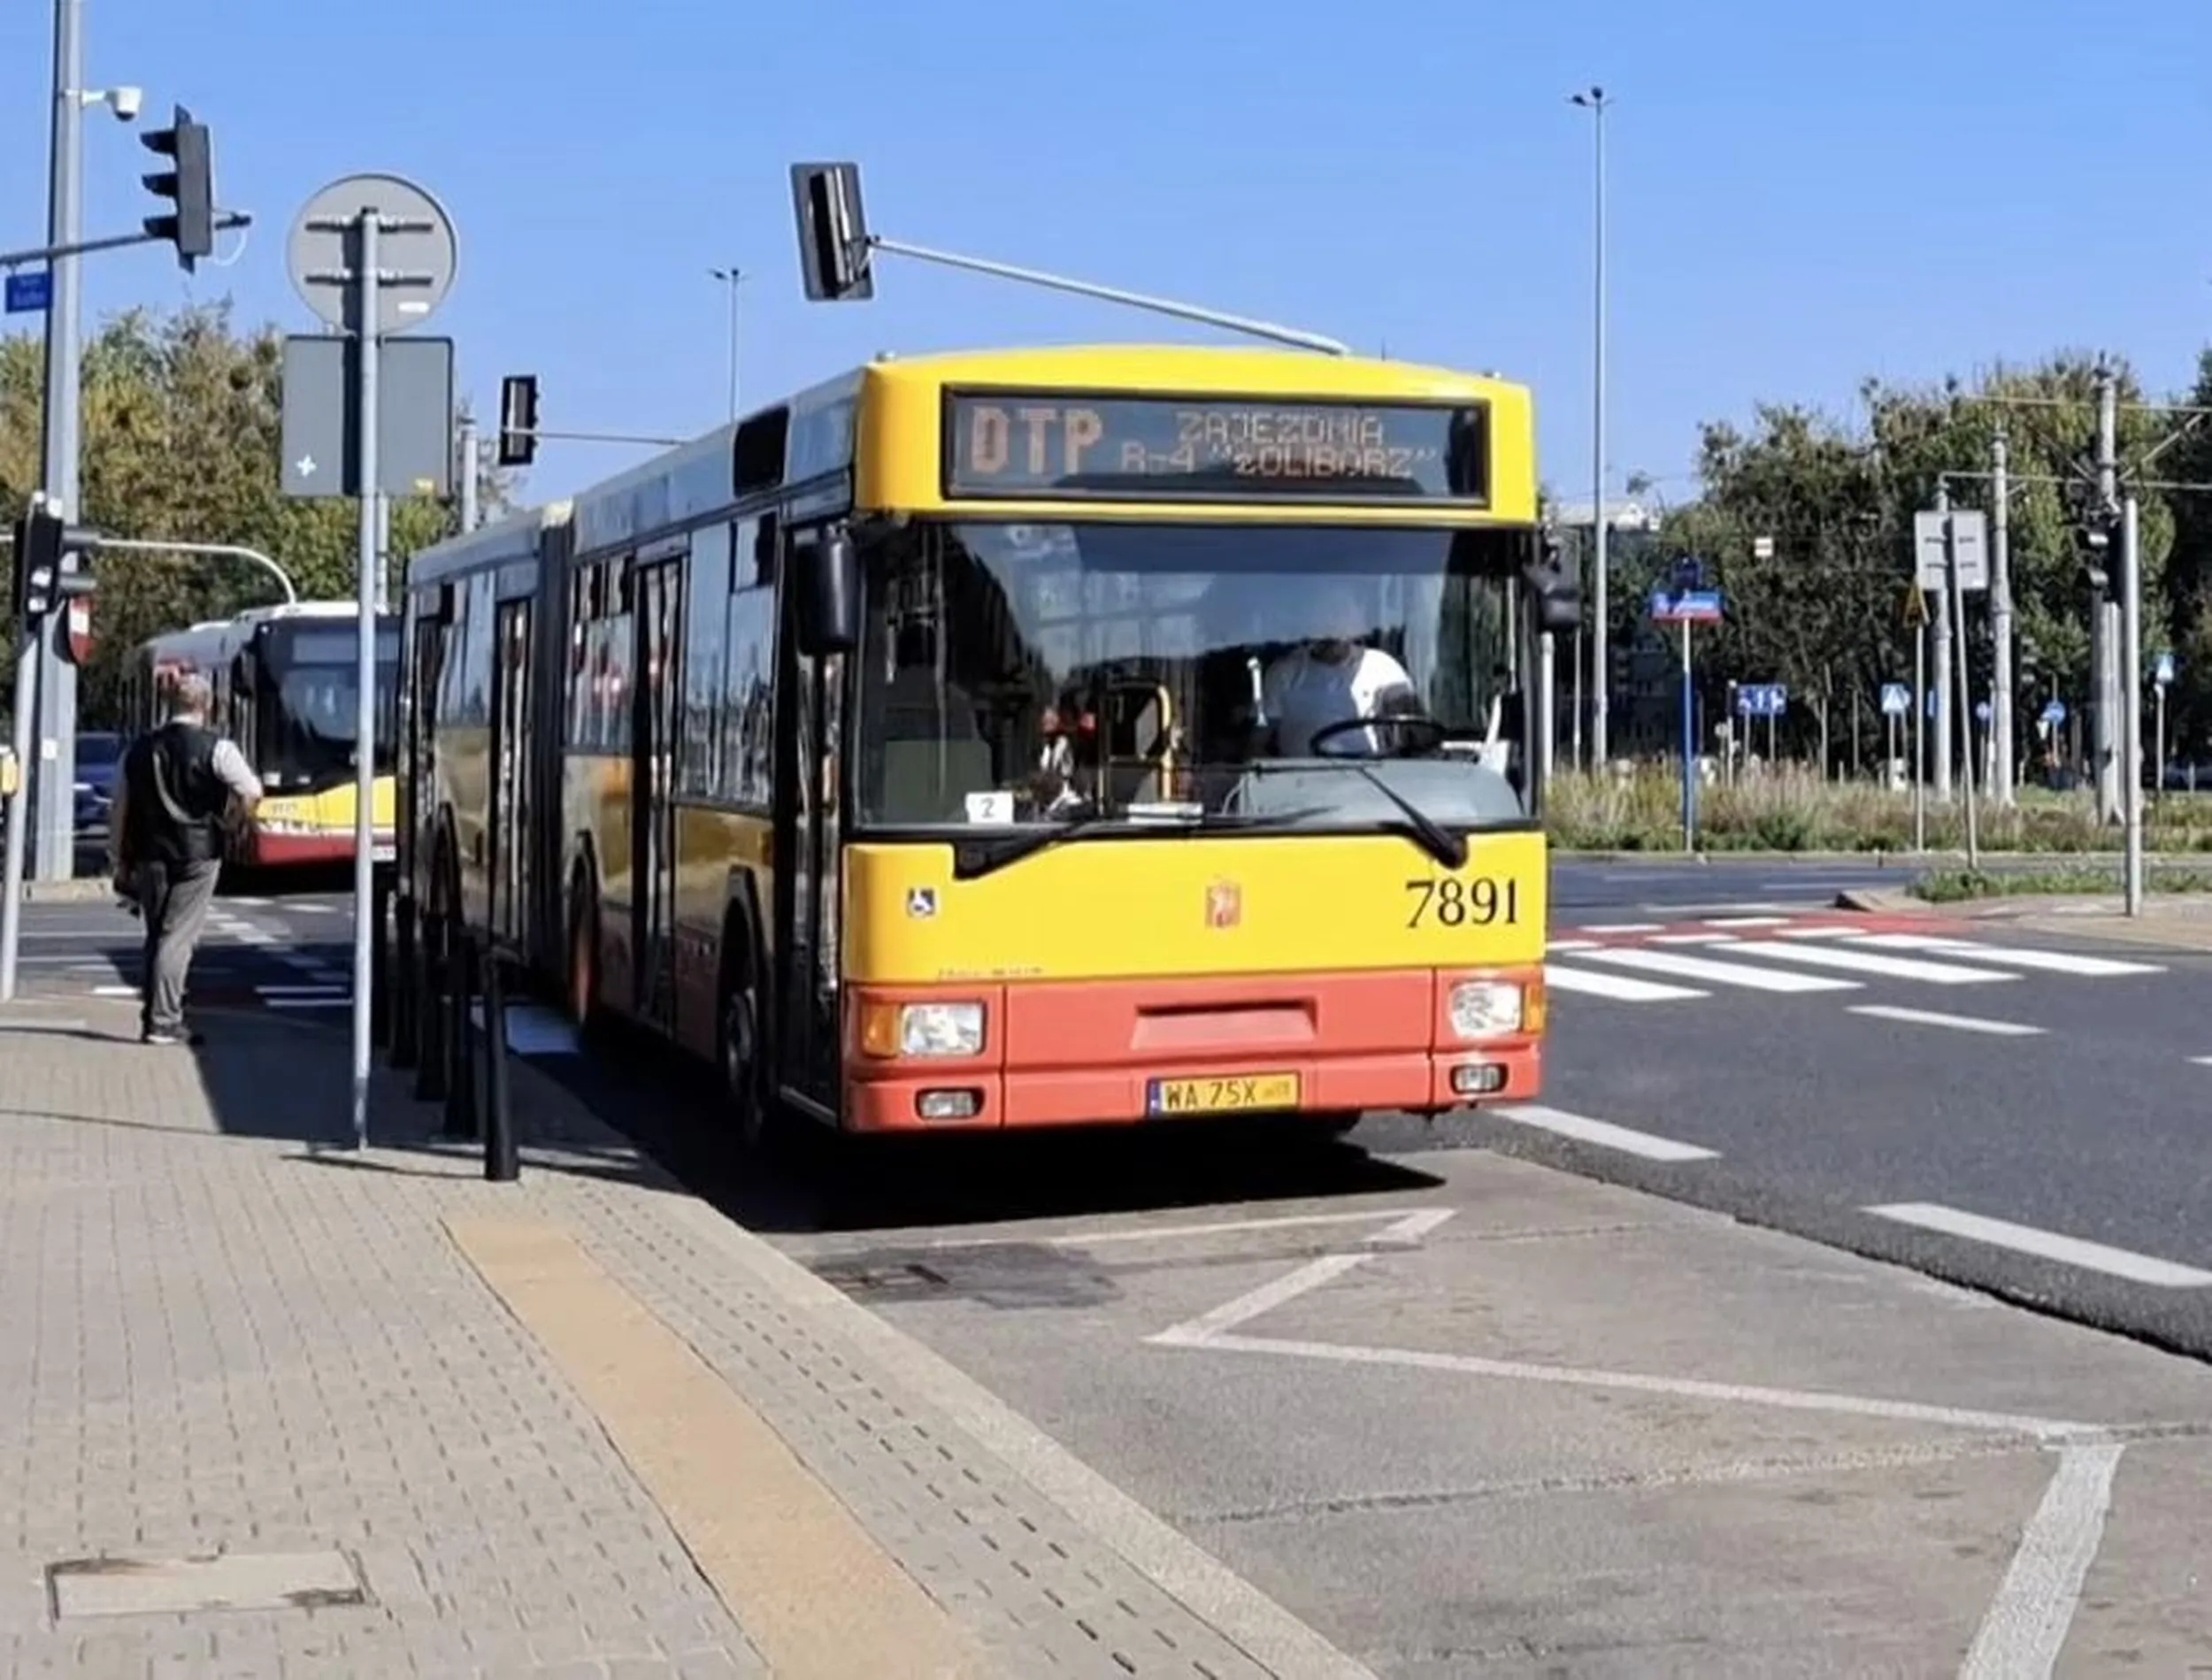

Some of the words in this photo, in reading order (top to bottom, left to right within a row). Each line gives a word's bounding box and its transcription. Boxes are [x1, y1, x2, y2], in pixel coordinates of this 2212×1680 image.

[972, 406, 1102, 476] DTP
[980, 797, 995, 819] 2
[1405, 877, 1517, 929] 7891
[1164, 1082, 1197, 1109] WA
[1210, 1079, 1256, 1106] 75X
